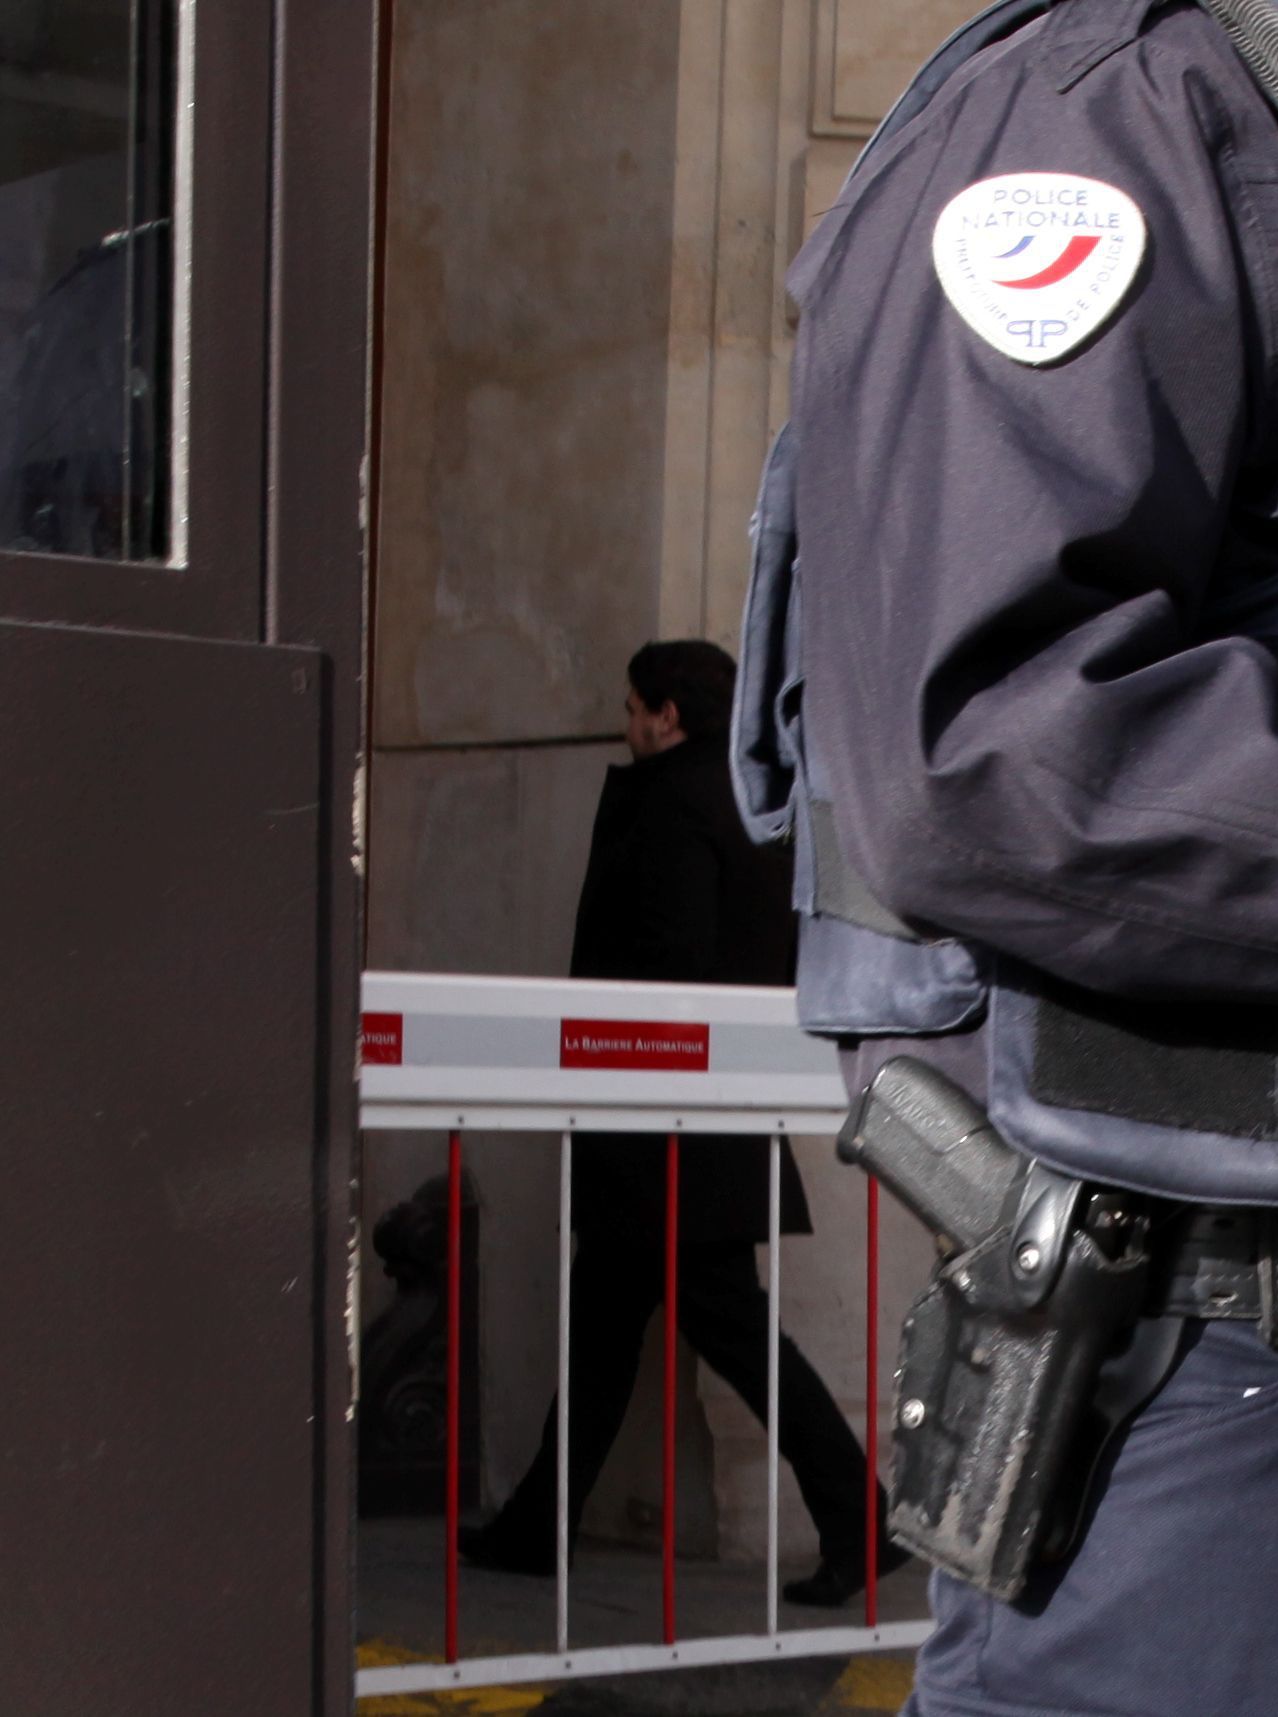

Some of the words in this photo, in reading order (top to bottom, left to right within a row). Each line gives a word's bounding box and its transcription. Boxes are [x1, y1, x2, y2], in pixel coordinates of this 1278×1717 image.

[993, 188, 1089, 206] POLICE
[961, 210, 1120, 230] NATIONALE
[361, 1031, 397, 1046] ATIQUE
[635, 1037, 705, 1053] AUTOMATIQUE
